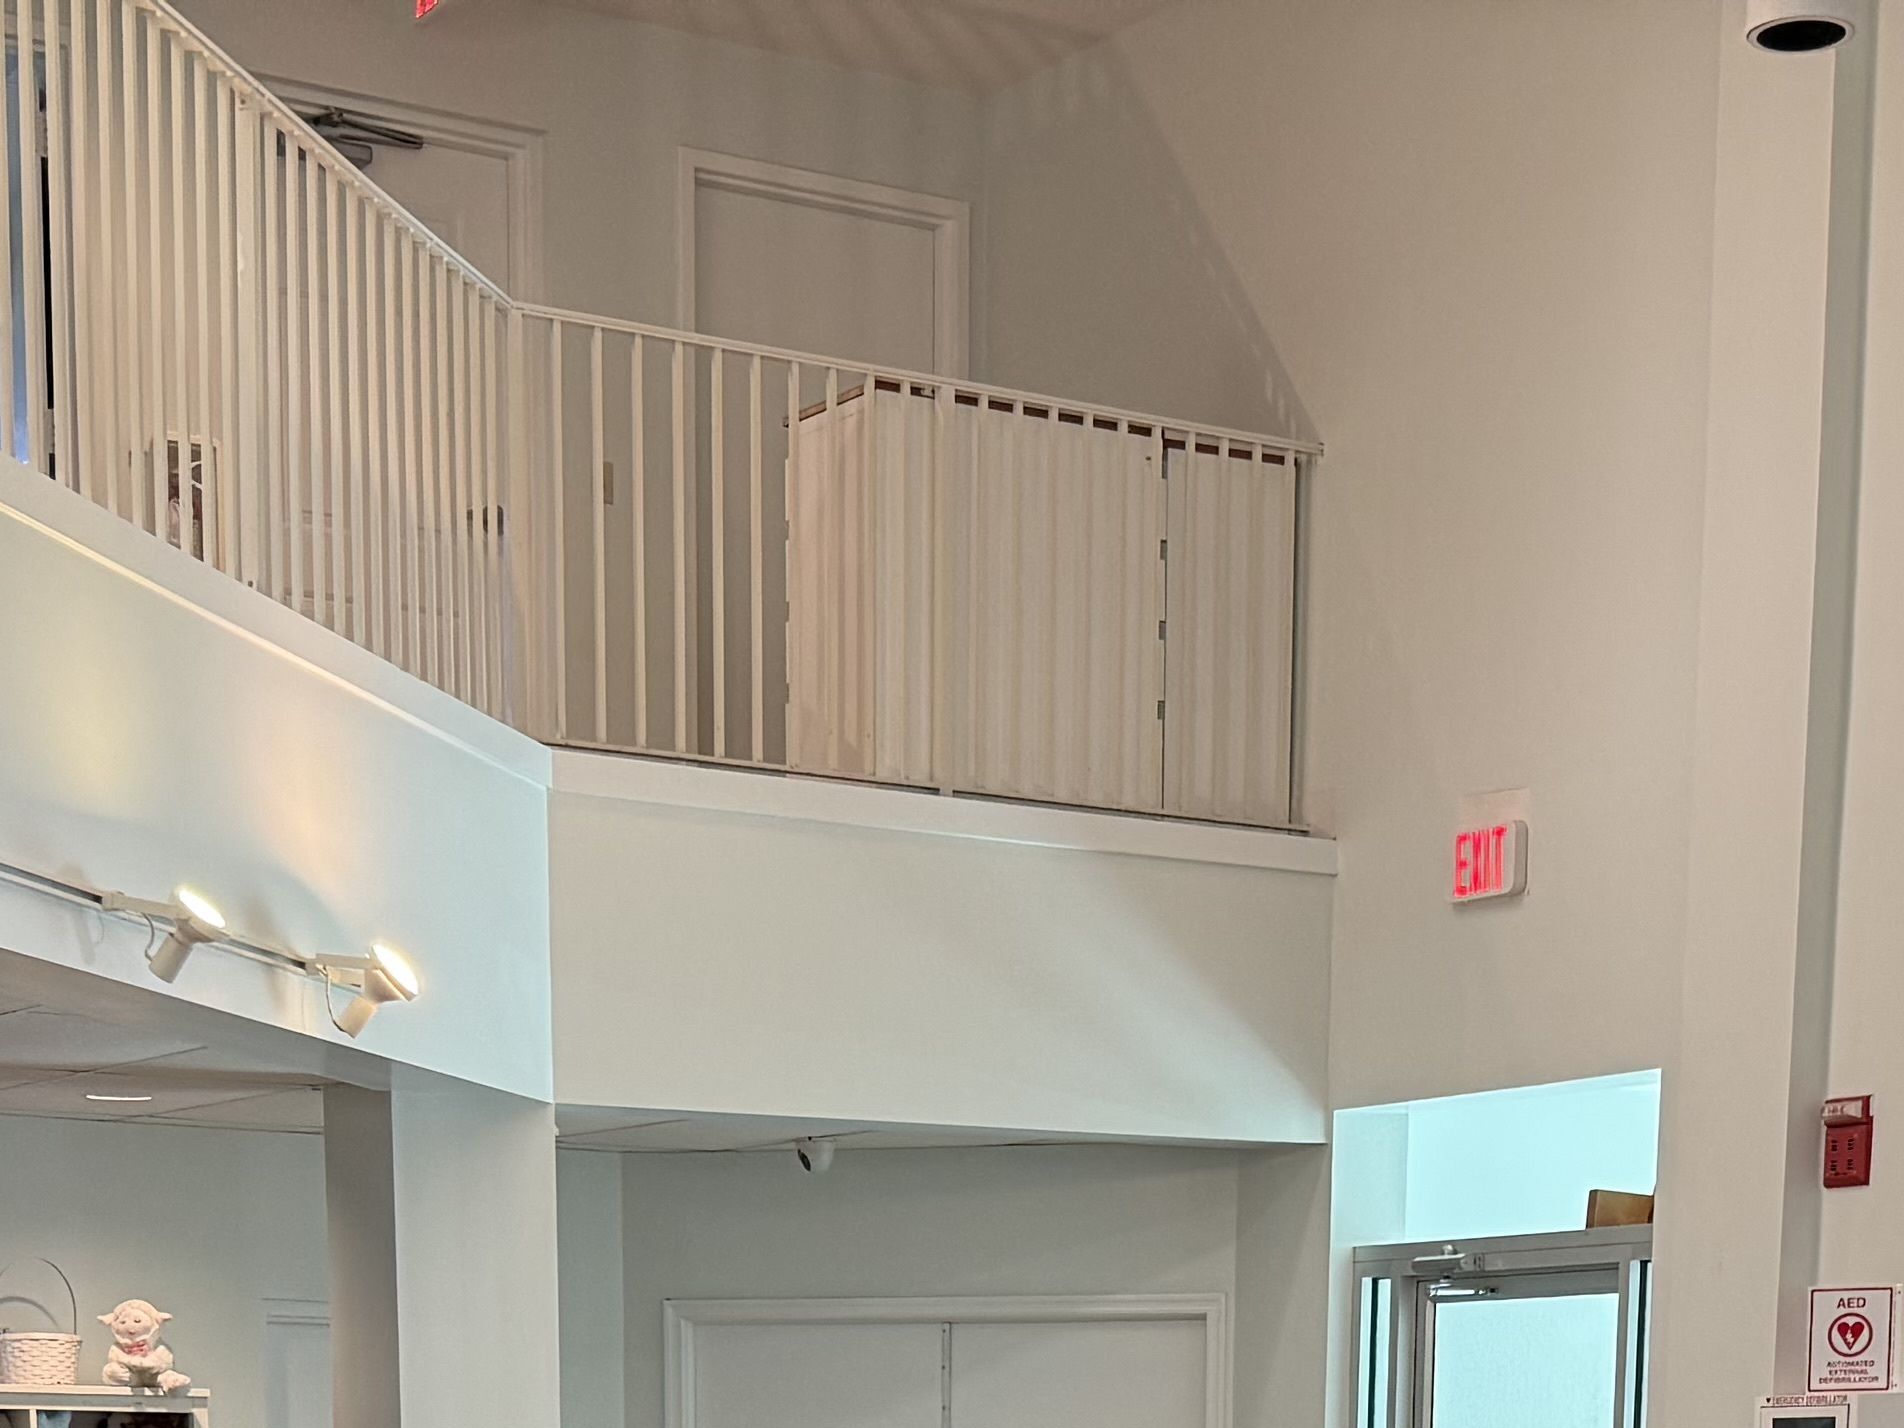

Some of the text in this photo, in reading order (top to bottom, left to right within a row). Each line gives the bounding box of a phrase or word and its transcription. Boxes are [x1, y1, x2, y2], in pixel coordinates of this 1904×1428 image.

[1454, 825, 1507, 897] EXIT
[1837, 1297, 1867, 1309] AED
[1827, 1360, 1876, 1368] AUTOMATED
